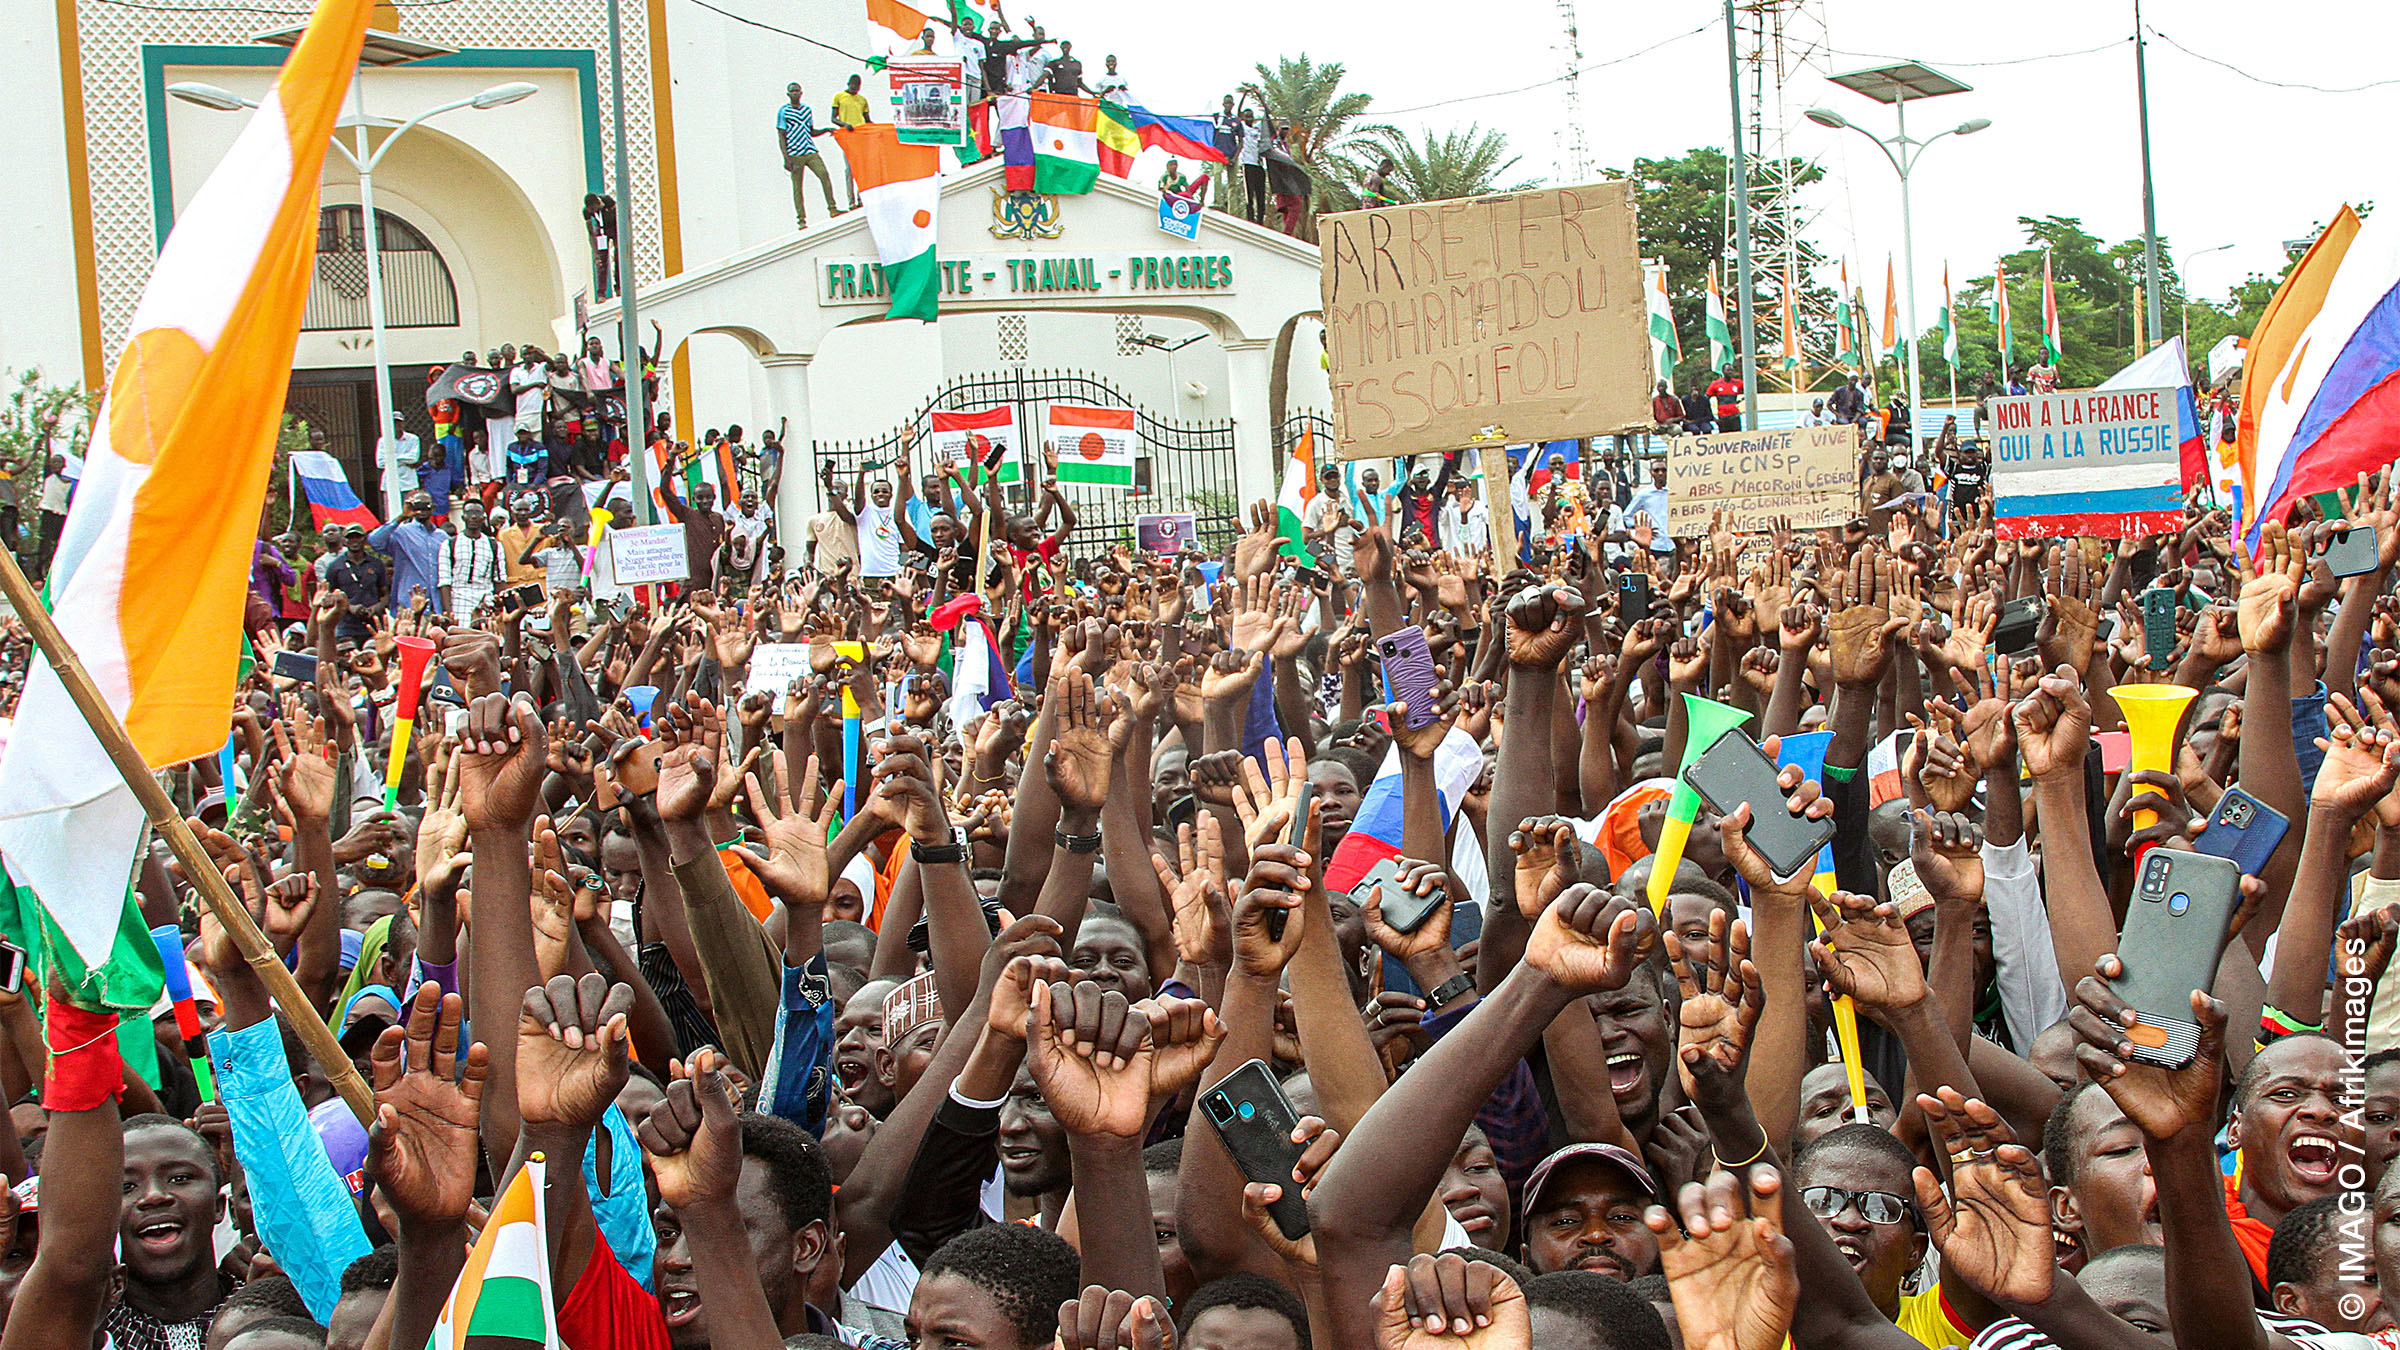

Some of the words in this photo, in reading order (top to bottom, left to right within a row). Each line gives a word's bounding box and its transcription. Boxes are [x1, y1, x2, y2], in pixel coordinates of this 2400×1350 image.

[1332, 189, 1596, 303] ARRETER
[826, 260, 973, 298] FRATITE
[1006, 258, 1102, 292] TRAVAIL
[1129, 255, 1233, 289] PROGRES
[1332, 264, 1607, 373] MAHAMADOU
[1336, 331, 1580, 444] ISSOUFOU
[1996, 402, 2031, 430] NON
[2041, 400, 2052, 426] A
[2061, 398, 2083, 425] LA
[2088, 392, 2160, 424] FRANCE
[1999, 434, 2031, 461] OUI
[2043, 432, 2054, 459] A
[2063, 431, 2085, 458] LA
[2099, 424, 2172, 456] RUSSIE
[1740, 454, 1801, 474] CNSP
[1671, 508, 1677, 517] A
[1682, 504, 1706, 516] BAS
